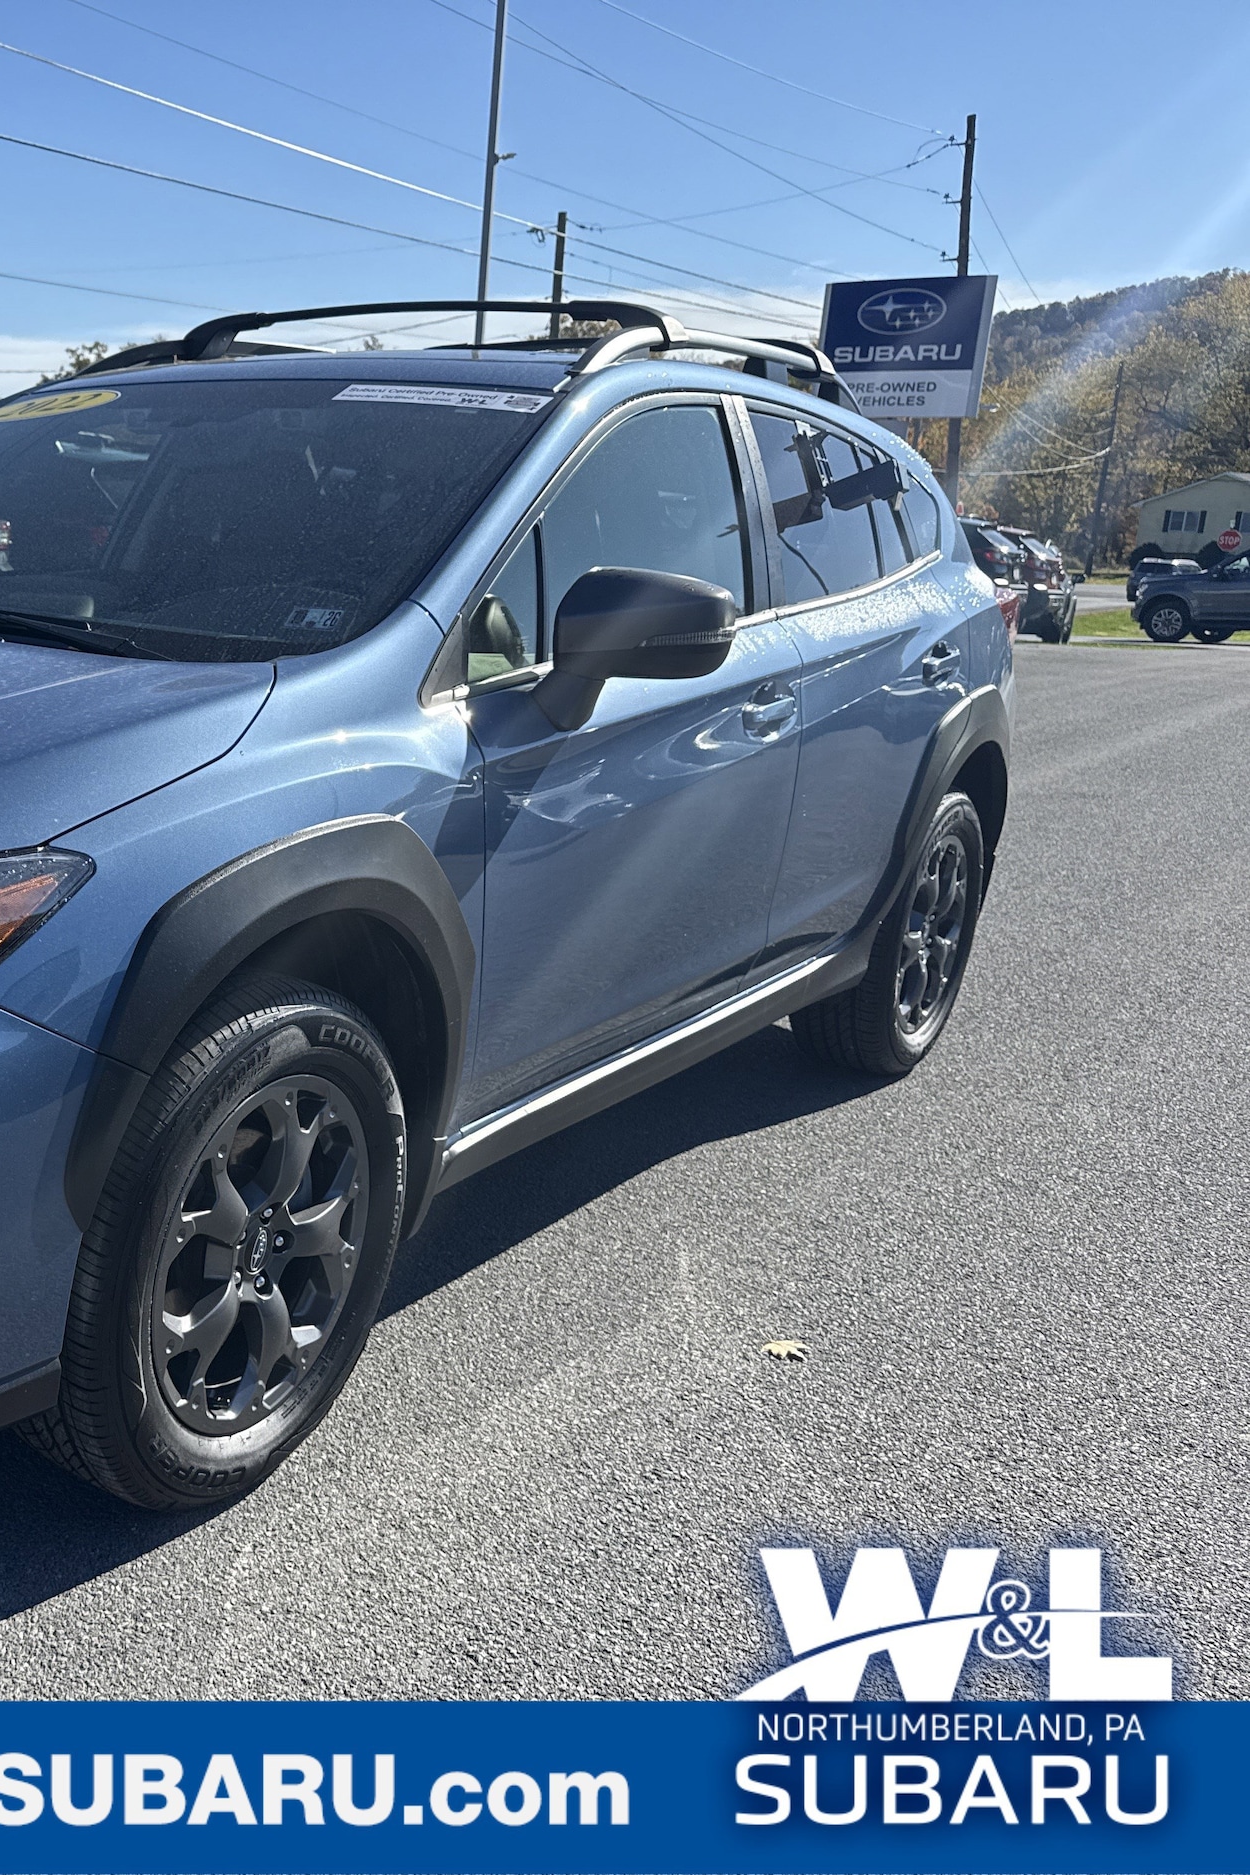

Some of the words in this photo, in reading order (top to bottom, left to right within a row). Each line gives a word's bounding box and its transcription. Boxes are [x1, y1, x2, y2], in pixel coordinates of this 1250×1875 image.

[833, 343, 963, 364] SUBARU
[348, 386, 386, 394] Subaru
[388, 388, 435, 396] Certified
[435, 390, 498, 401] Pre-Owned
[847, 381, 937, 394] PRE-OWNED
[1219, 535, 1240, 546] STOP
[318, 1024, 395, 1102] COOPER
[149, 1432, 247, 1488] COOPER
